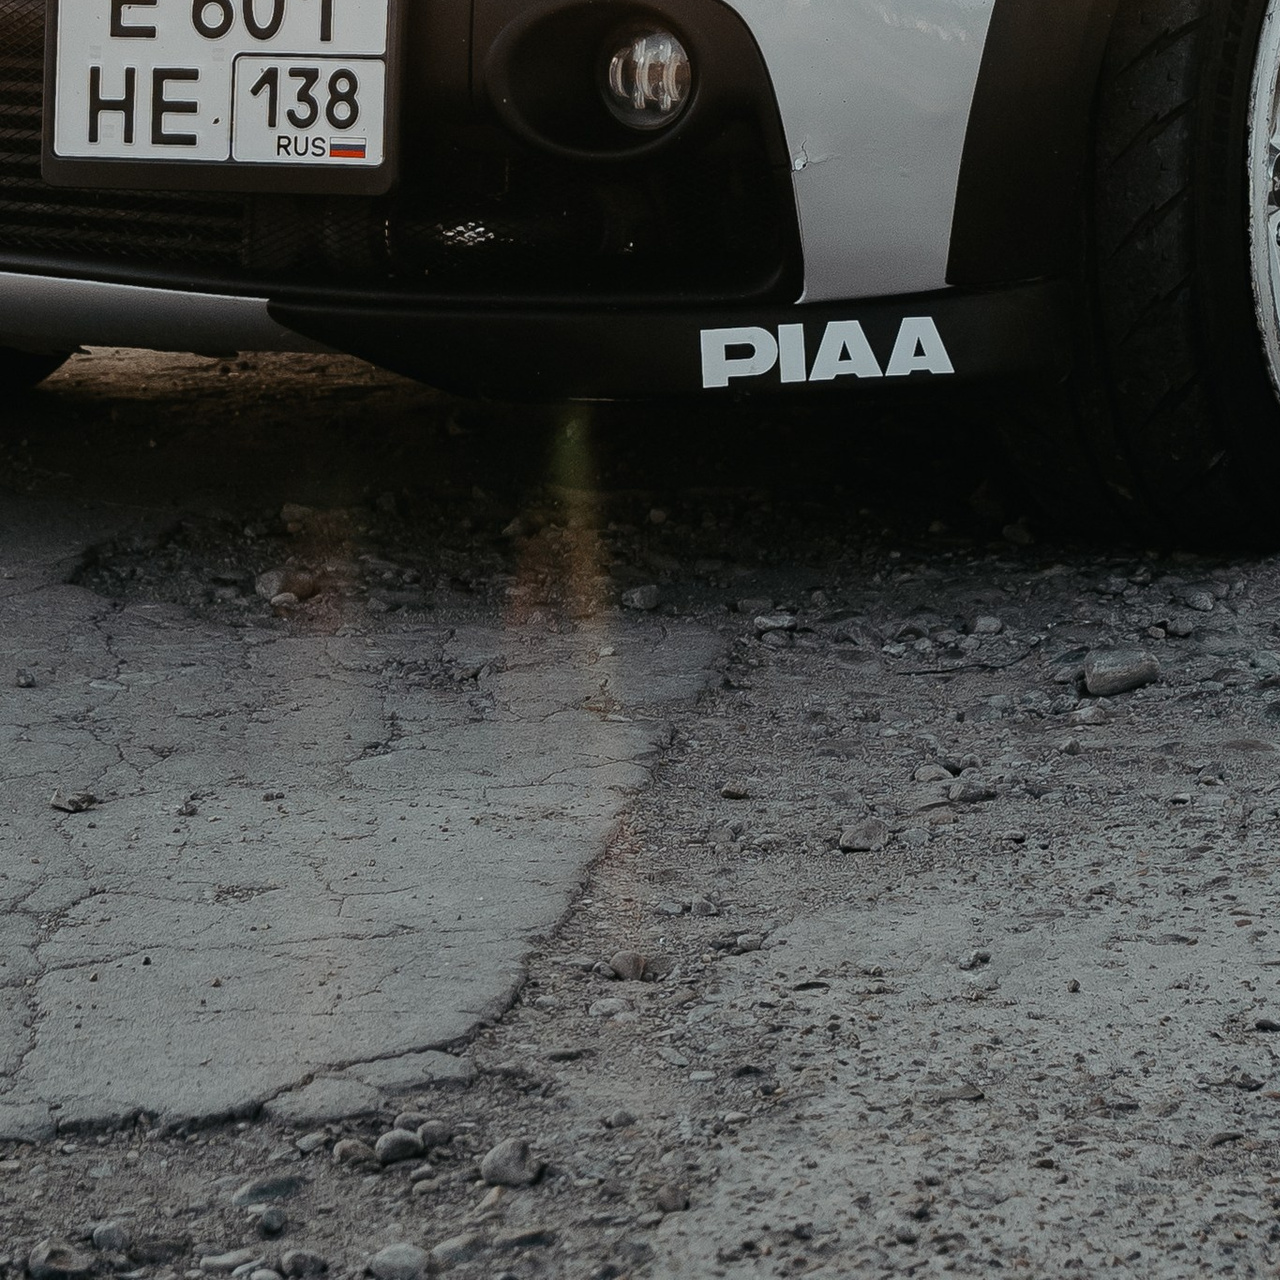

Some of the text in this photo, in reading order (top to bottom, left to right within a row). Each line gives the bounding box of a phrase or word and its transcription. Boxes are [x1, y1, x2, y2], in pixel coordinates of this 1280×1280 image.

[249, 67, 359, 130] 138
[276, 135, 326, 157] RUS
[700, 316, 955, 388] PIAA
